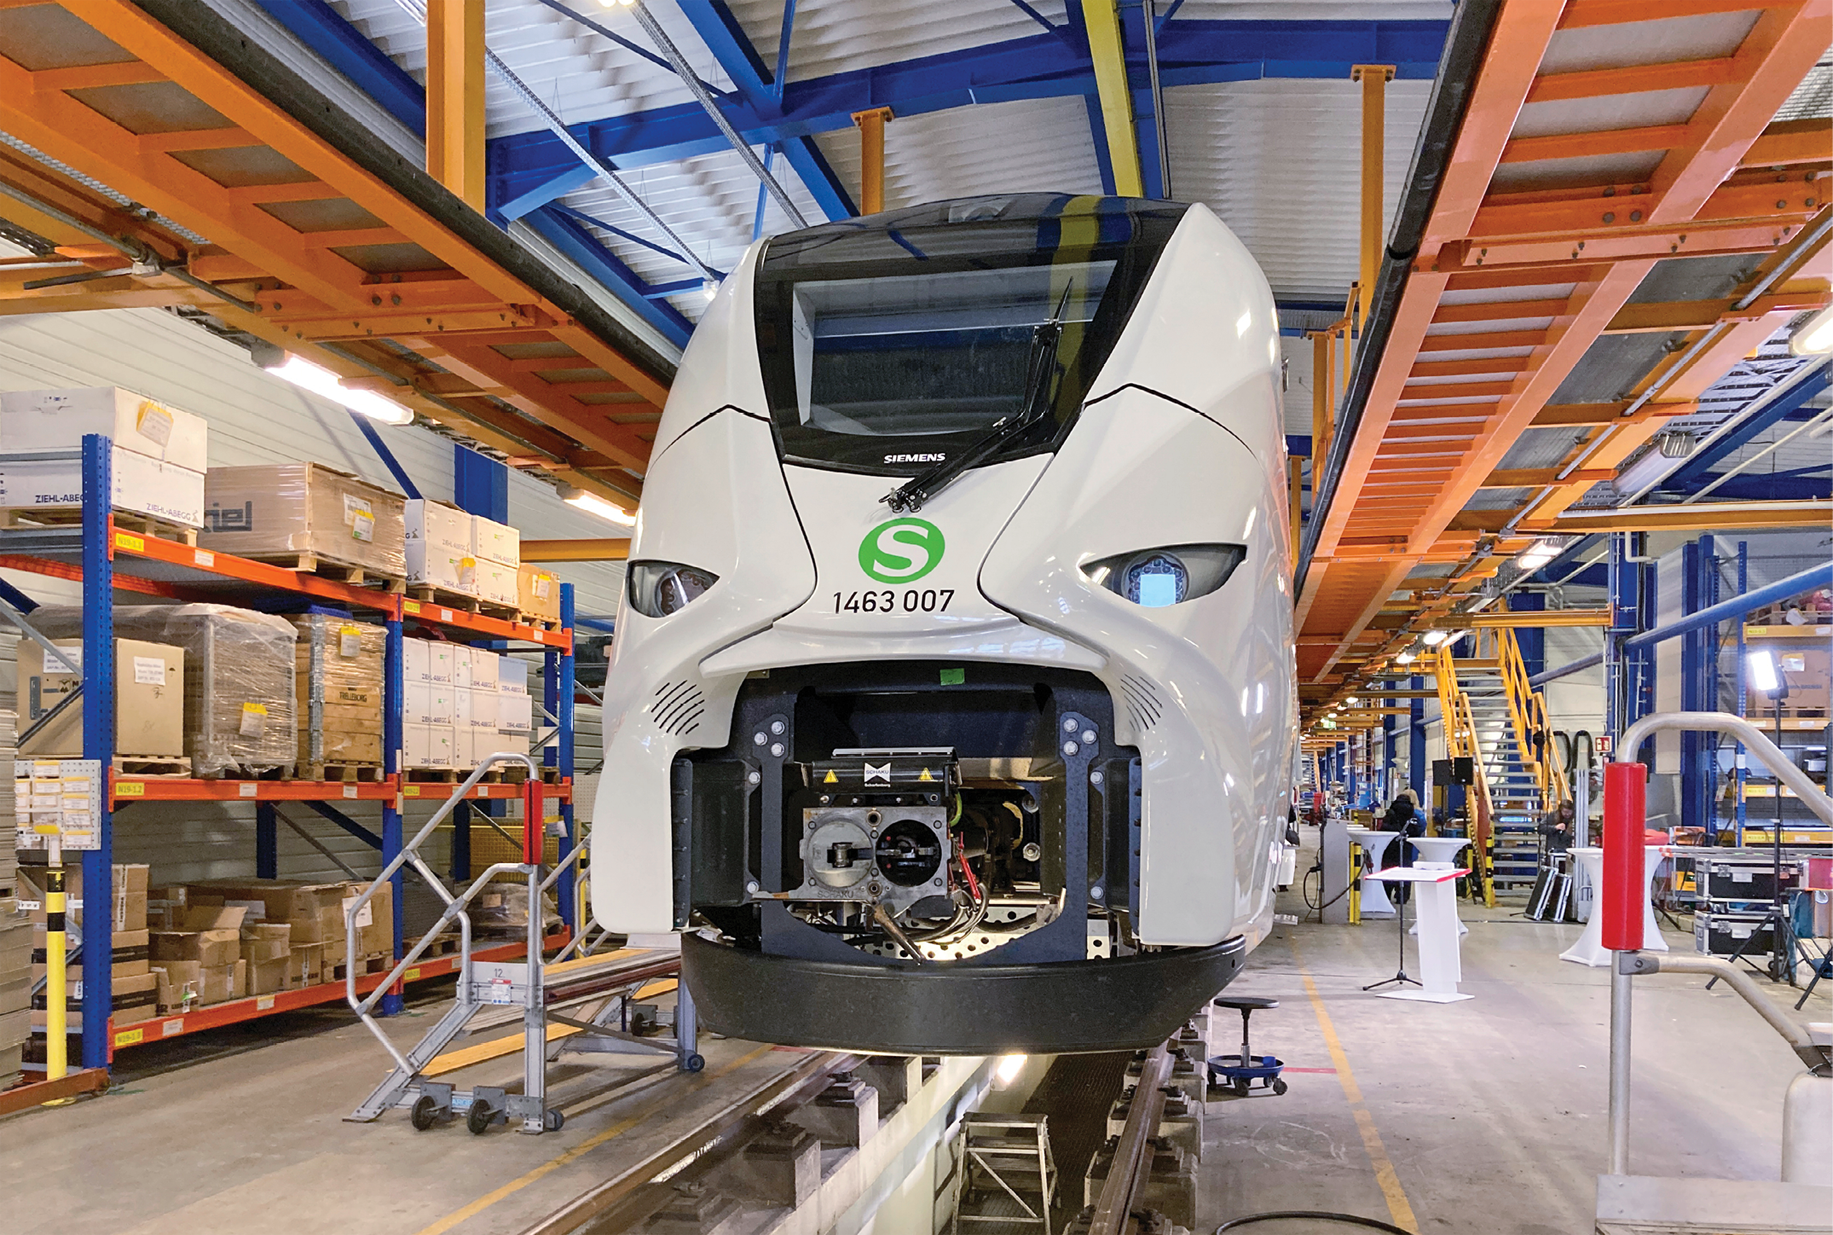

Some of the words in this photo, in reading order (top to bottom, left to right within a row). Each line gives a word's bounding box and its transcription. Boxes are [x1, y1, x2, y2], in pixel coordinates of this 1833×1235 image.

[883, 452, 946, 464] SIEMENS
[35, 493, 84, 503] ZIEHL-ABE
[146, 503, 191, 521] ZIEHL-ABEGG
[872, 524, 930, 577] S
[833, 590, 895, 614] 1463
[903, 589, 956, 612] 007
[118, 785, 142, 793] N19-1.2
[494, 968, 503, 978] 12
